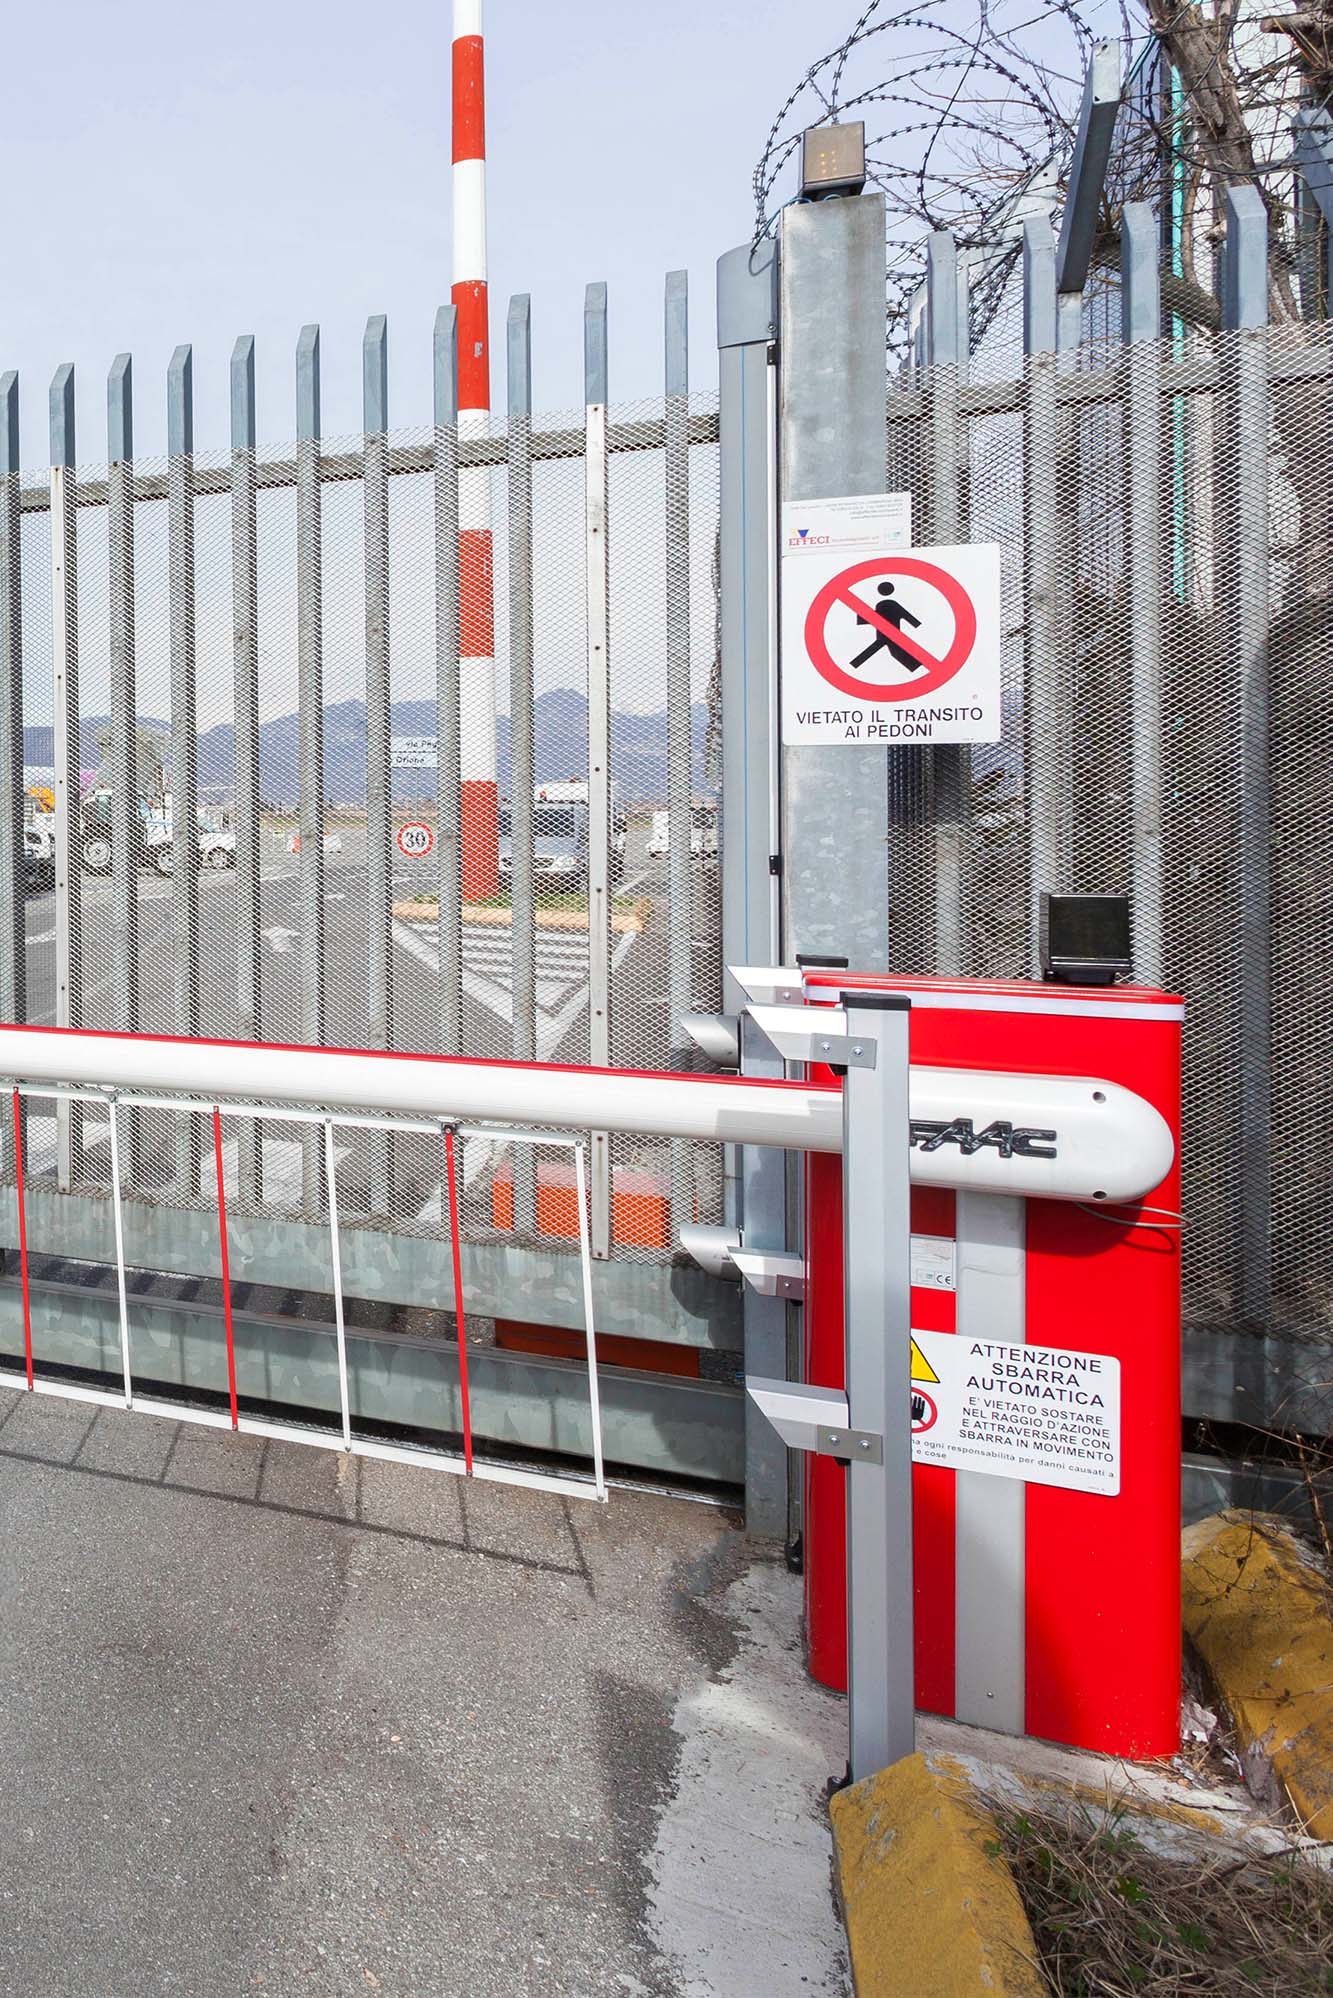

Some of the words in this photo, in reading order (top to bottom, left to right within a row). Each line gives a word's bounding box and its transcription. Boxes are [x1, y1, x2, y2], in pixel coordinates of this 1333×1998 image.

[788, 535, 830, 547] EFFECI
[796, 710, 864, 724] VIETATO
[870, 710, 886, 722] IL
[893, 706, 984, 723] TRANSITO
[844, 725, 861, 738] AI
[867, 724, 933, 738] PEDONI
[405, 831, 426, 848] 30
[970, 1343, 1102, 1374] ATTENZIONE
[992, 1362, 1081, 1388] SBARRA
[966, 1375, 1105, 1409] AUTOMATICA
[962, 1408, 987, 1419] NEL
[991, 1412, 1043, 1428] RAGGIO
[1047, 1420, 1110, 1438] D'AZIONE
[969, 1397, 980, 1406] E'
[984, 1399, 1037, 1415] VIETATO
[1041, 1408, 1103, 1426] SOSTARE
[959, 1430, 1012, 1446] SBARRA
[1016, 1439, 1029, 1449] IN
[1033, 1442, 1114, 1463] MOVIMENTO
[962, 1419, 969, 1428] E
[973, 1421, 1077, 1445] ATTRAVERSARE
[1081, 1437, 1111, 1451] CON
[924, 1450, 947, 1459] cose
[924, 1441, 944, 1449] ogni
[1037, 1459, 1066, 1470] danni
[1068, 1465, 1105, 1477] causati
